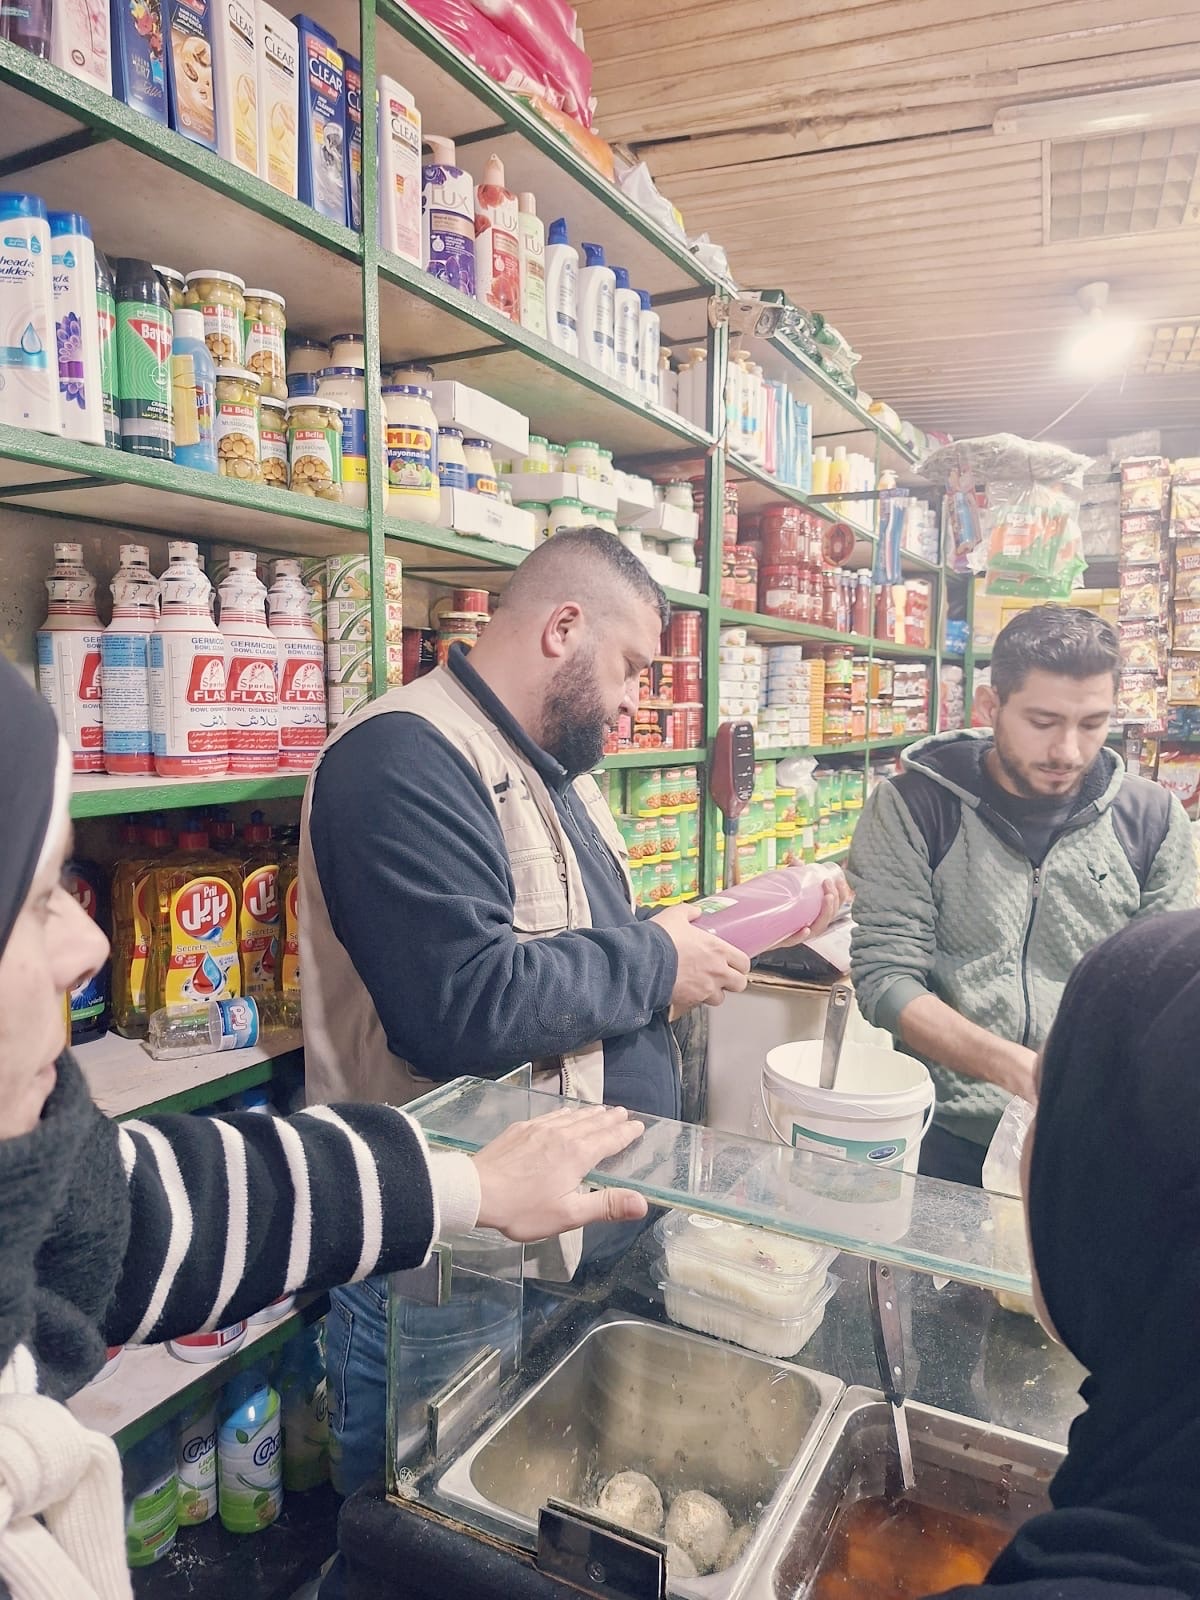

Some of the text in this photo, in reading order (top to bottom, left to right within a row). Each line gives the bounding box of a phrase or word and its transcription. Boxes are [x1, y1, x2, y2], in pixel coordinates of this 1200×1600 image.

[228, 3, 254, 38] CLEAR
[264, 35, 295, 67] CLEAR
[309, 58, 343, 93] CLEAR
[391, 118, 419, 145] CLEAR
[432, 186, 470, 215] LUX
[203, 306, 234, 318] La Bella
[254, 324, 263, 332] La
[222, 405, 254, 416] La Bella
[262, 431, 272, 439] La
[295, 430, 325, 439] La Bella
[387, 431, 428, 448] MIA
[203, 885, 218, 897] Pril
[181, 892, 229, 931] بريل
[247, 928, 274, 937] Secrets
[176, 943, 208, 953] Secrets
